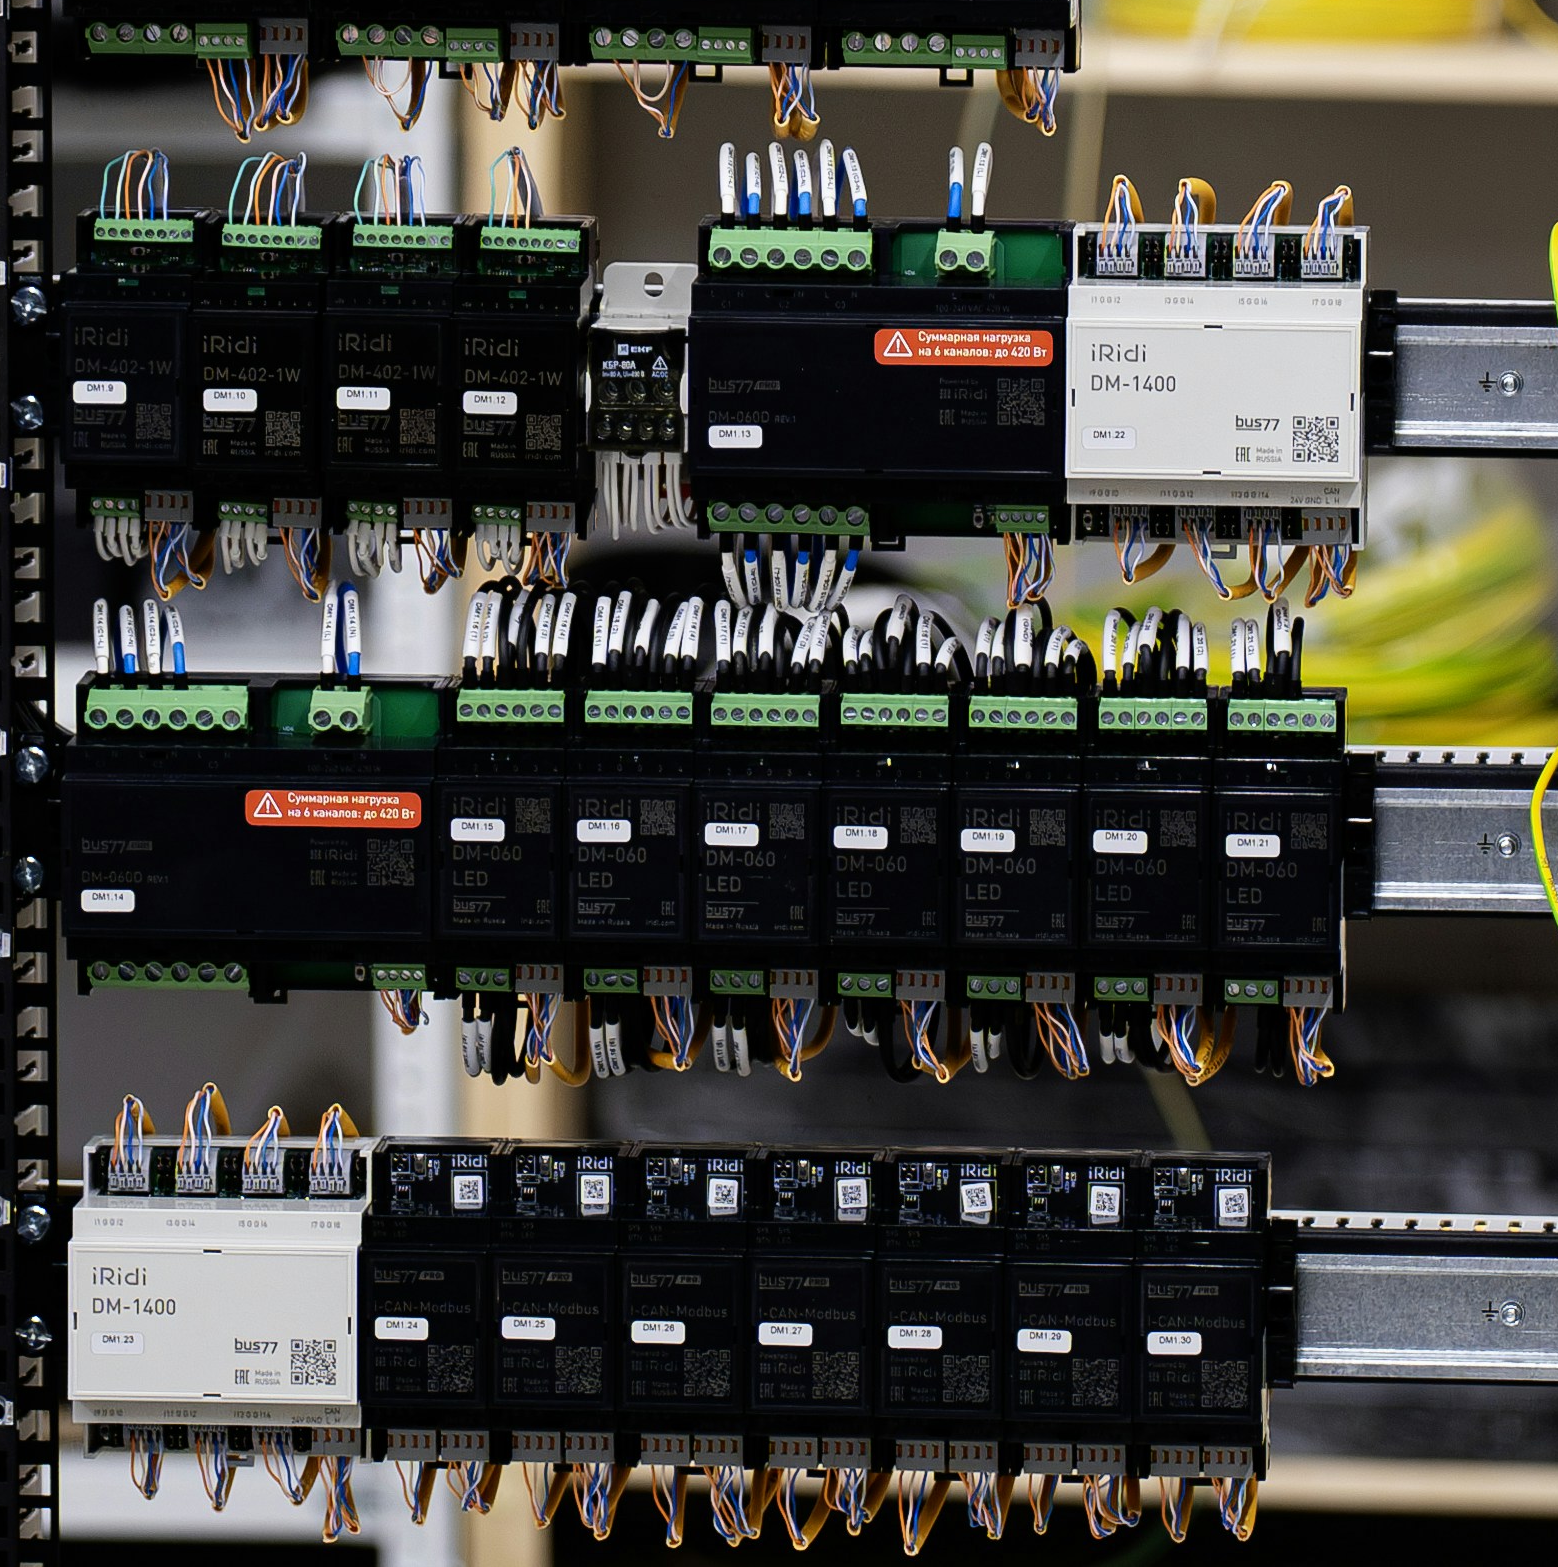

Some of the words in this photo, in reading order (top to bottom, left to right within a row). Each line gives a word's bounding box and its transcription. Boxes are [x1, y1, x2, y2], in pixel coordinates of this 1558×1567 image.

[919, 331, 979, 344] Суммарная
[983, 334, 1030, 344] нагрузка
[919, 348, 931, 356] на
[935, 346, 941, 356] 6
[944, 348, 992, 357] каналов:
[995, 349, 1008, 358] до
[1011, 347, 1030, 357] 420
[1034, 347, 1047, 357] Вт
[1092, 344, 1146, 362] iRidi
[1092, 375, 1175, 392] DM-1400
[1236, 415, 1280, 431] bus77
[288, 792, 348, 805] Суммарная
[352, 796, 399, 806] нагрузка
[288, 809, 301, 817] на
[304, 807, 310, 817] 6
[313, 810, 361, 818] каналов:
[364, 811, 377, 819] до
[380, 808, 399, 818] 420
[402, 809, 415, 819] Вт
[452, 1154, 487, 1167] iRidi
[578, 1156, 612, 1169] iRidi
[708, 1159, 743, 1172] iRidi
[836, 1161, 870, 1174] iRidi
[961, 1164, 996, 1177] iRidi
[1089, 1167, 1124, 1179] iRidi
[1214, 1169, 1251, 1182] iRidi
[93, 1267, 146, 1285] iRidi
[93, 1298, 175, 1315] DM-1400
[235, 1338, 278, 1354] bus77
